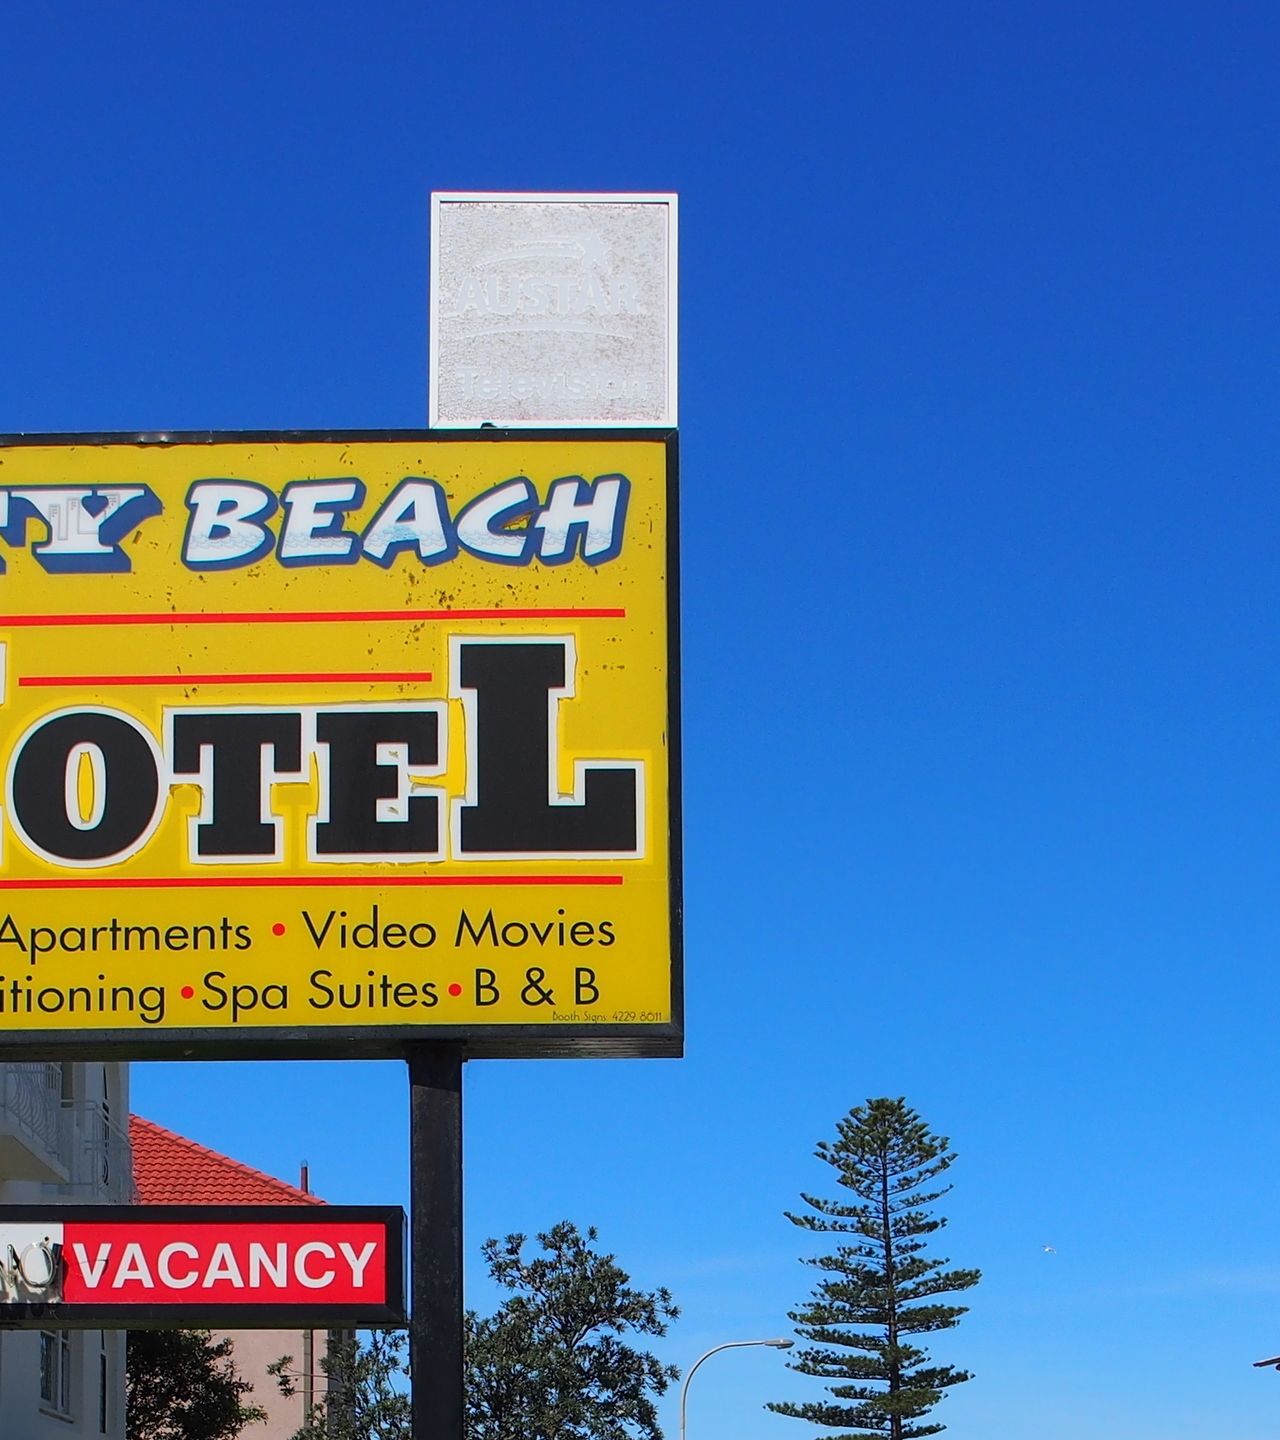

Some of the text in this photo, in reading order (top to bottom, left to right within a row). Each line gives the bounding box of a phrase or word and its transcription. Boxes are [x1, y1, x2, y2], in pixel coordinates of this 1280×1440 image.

[455, 273, 641, 316] AUSTAR
[455, 364, 653, 400] Television
[179, 474, 631, 572] BEACH
[300, 904, 437, 950] Video
[454, 904, 616, 948] Movies
[201, 971, 289, 1020] Spa
[308, 969, 440, 1009] Suites
[475, 969, 500, 1007] B
[520, 968, 556, 1007] &
[575, 967, 600, 1005] B
[612, 1010, 636, 1022] 4229
[73, 1241, 377, 1289] VACANCY
